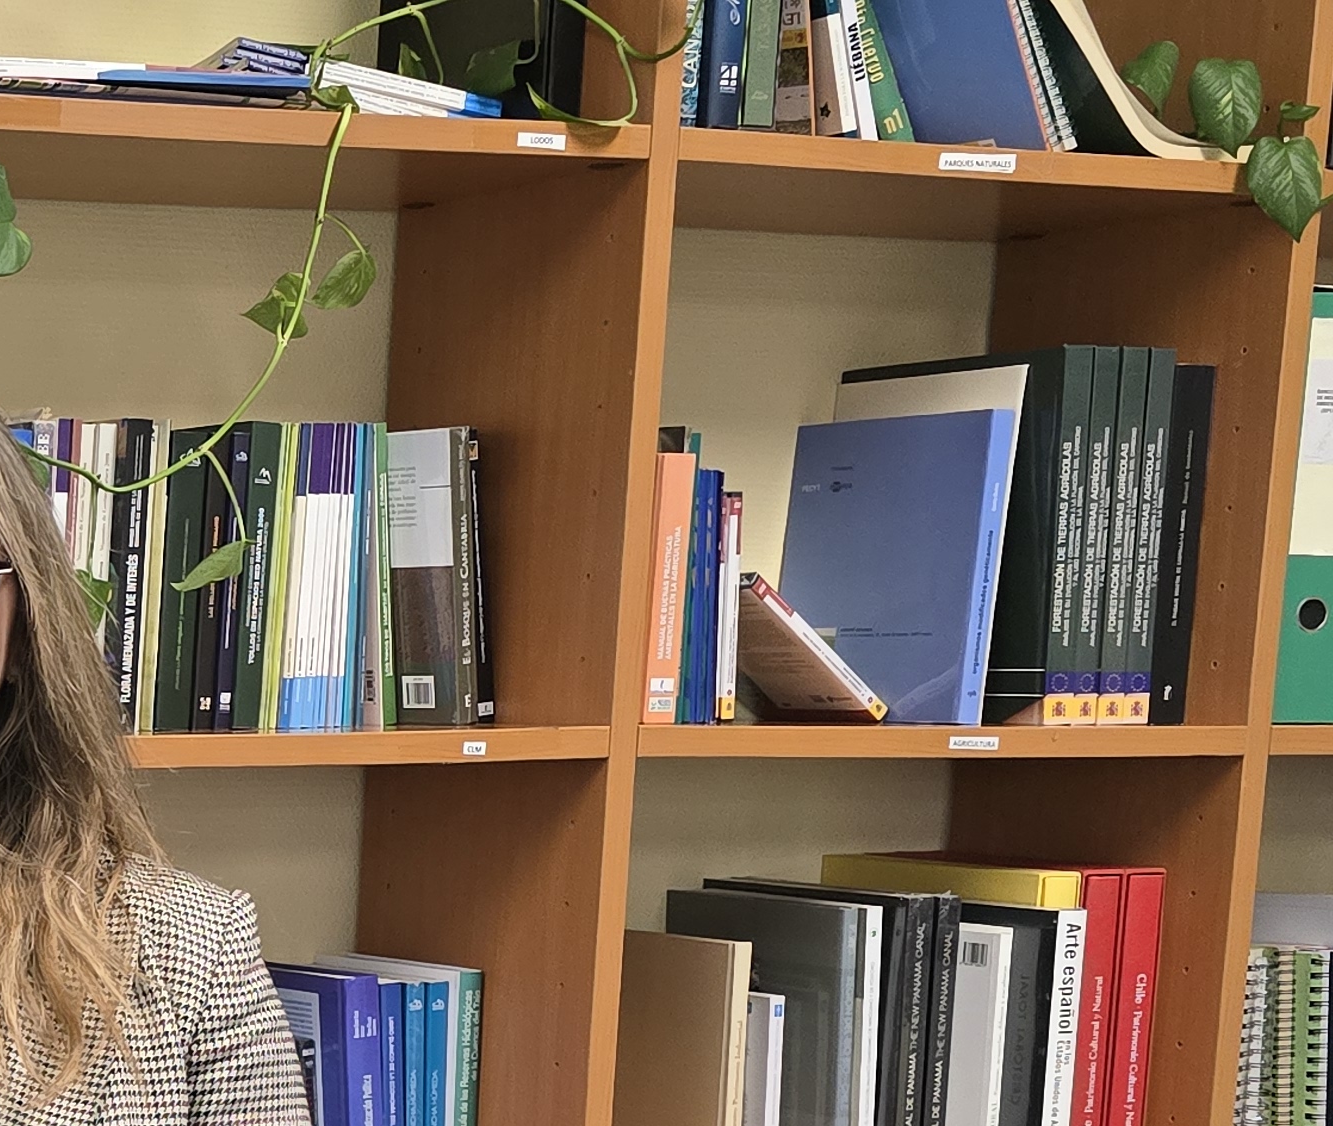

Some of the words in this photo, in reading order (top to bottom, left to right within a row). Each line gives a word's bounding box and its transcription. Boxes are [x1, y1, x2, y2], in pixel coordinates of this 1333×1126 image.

[944, 159, 973, 168] PARQUES
[976, 159, 1011, 169] NATURALES
[1058, 441, 1072, 500] AGRÍCOLAS
[1140, 441, 1156, 500] AGRÍCOLAS
[1056, 502, 1070, 545] TIERRAS
[1138, 502, 1151, 545] TIERRAS
[460, 512, 470, 579] CANTABRIA
[1055, 545, 1066, 561] DE
[1137, 545, 1147, 561] DE
[126, 591, 138, 606] DE
[1051, 562, 1065, 633] FORESTACIÓN
[1132, 562, 1146, 633] FORESTACIÓN
[121, 615, 137, 672] AMENAZADA
[119, 672, 136, 702] FLORA
[953, 739, 996, 748] AGRICULTURA
[914, 922, 927, 959] CANAL
[1064, 922, 1083, 960] Arte
[1057, 966, 1076, 1035] español
[1091, 975, 1104, 1012] Natural
[1133, 973, 1147, 1005] Chile
[460, 990, 474, 1047] Hidrológicas
[909, 1005, 921, 1030] NEW
[1129, 1010, 1143, 1063] Patrimonio
[907, 1031, 919, 1051] THE
[1087, 1020, 1100, 1060] Cultural
[1083, 1060, 1097, 1113] Patrimonio
[1126, 1063, 1139, 1103] Cultural
[905, 1096, 914, 1111] DE
